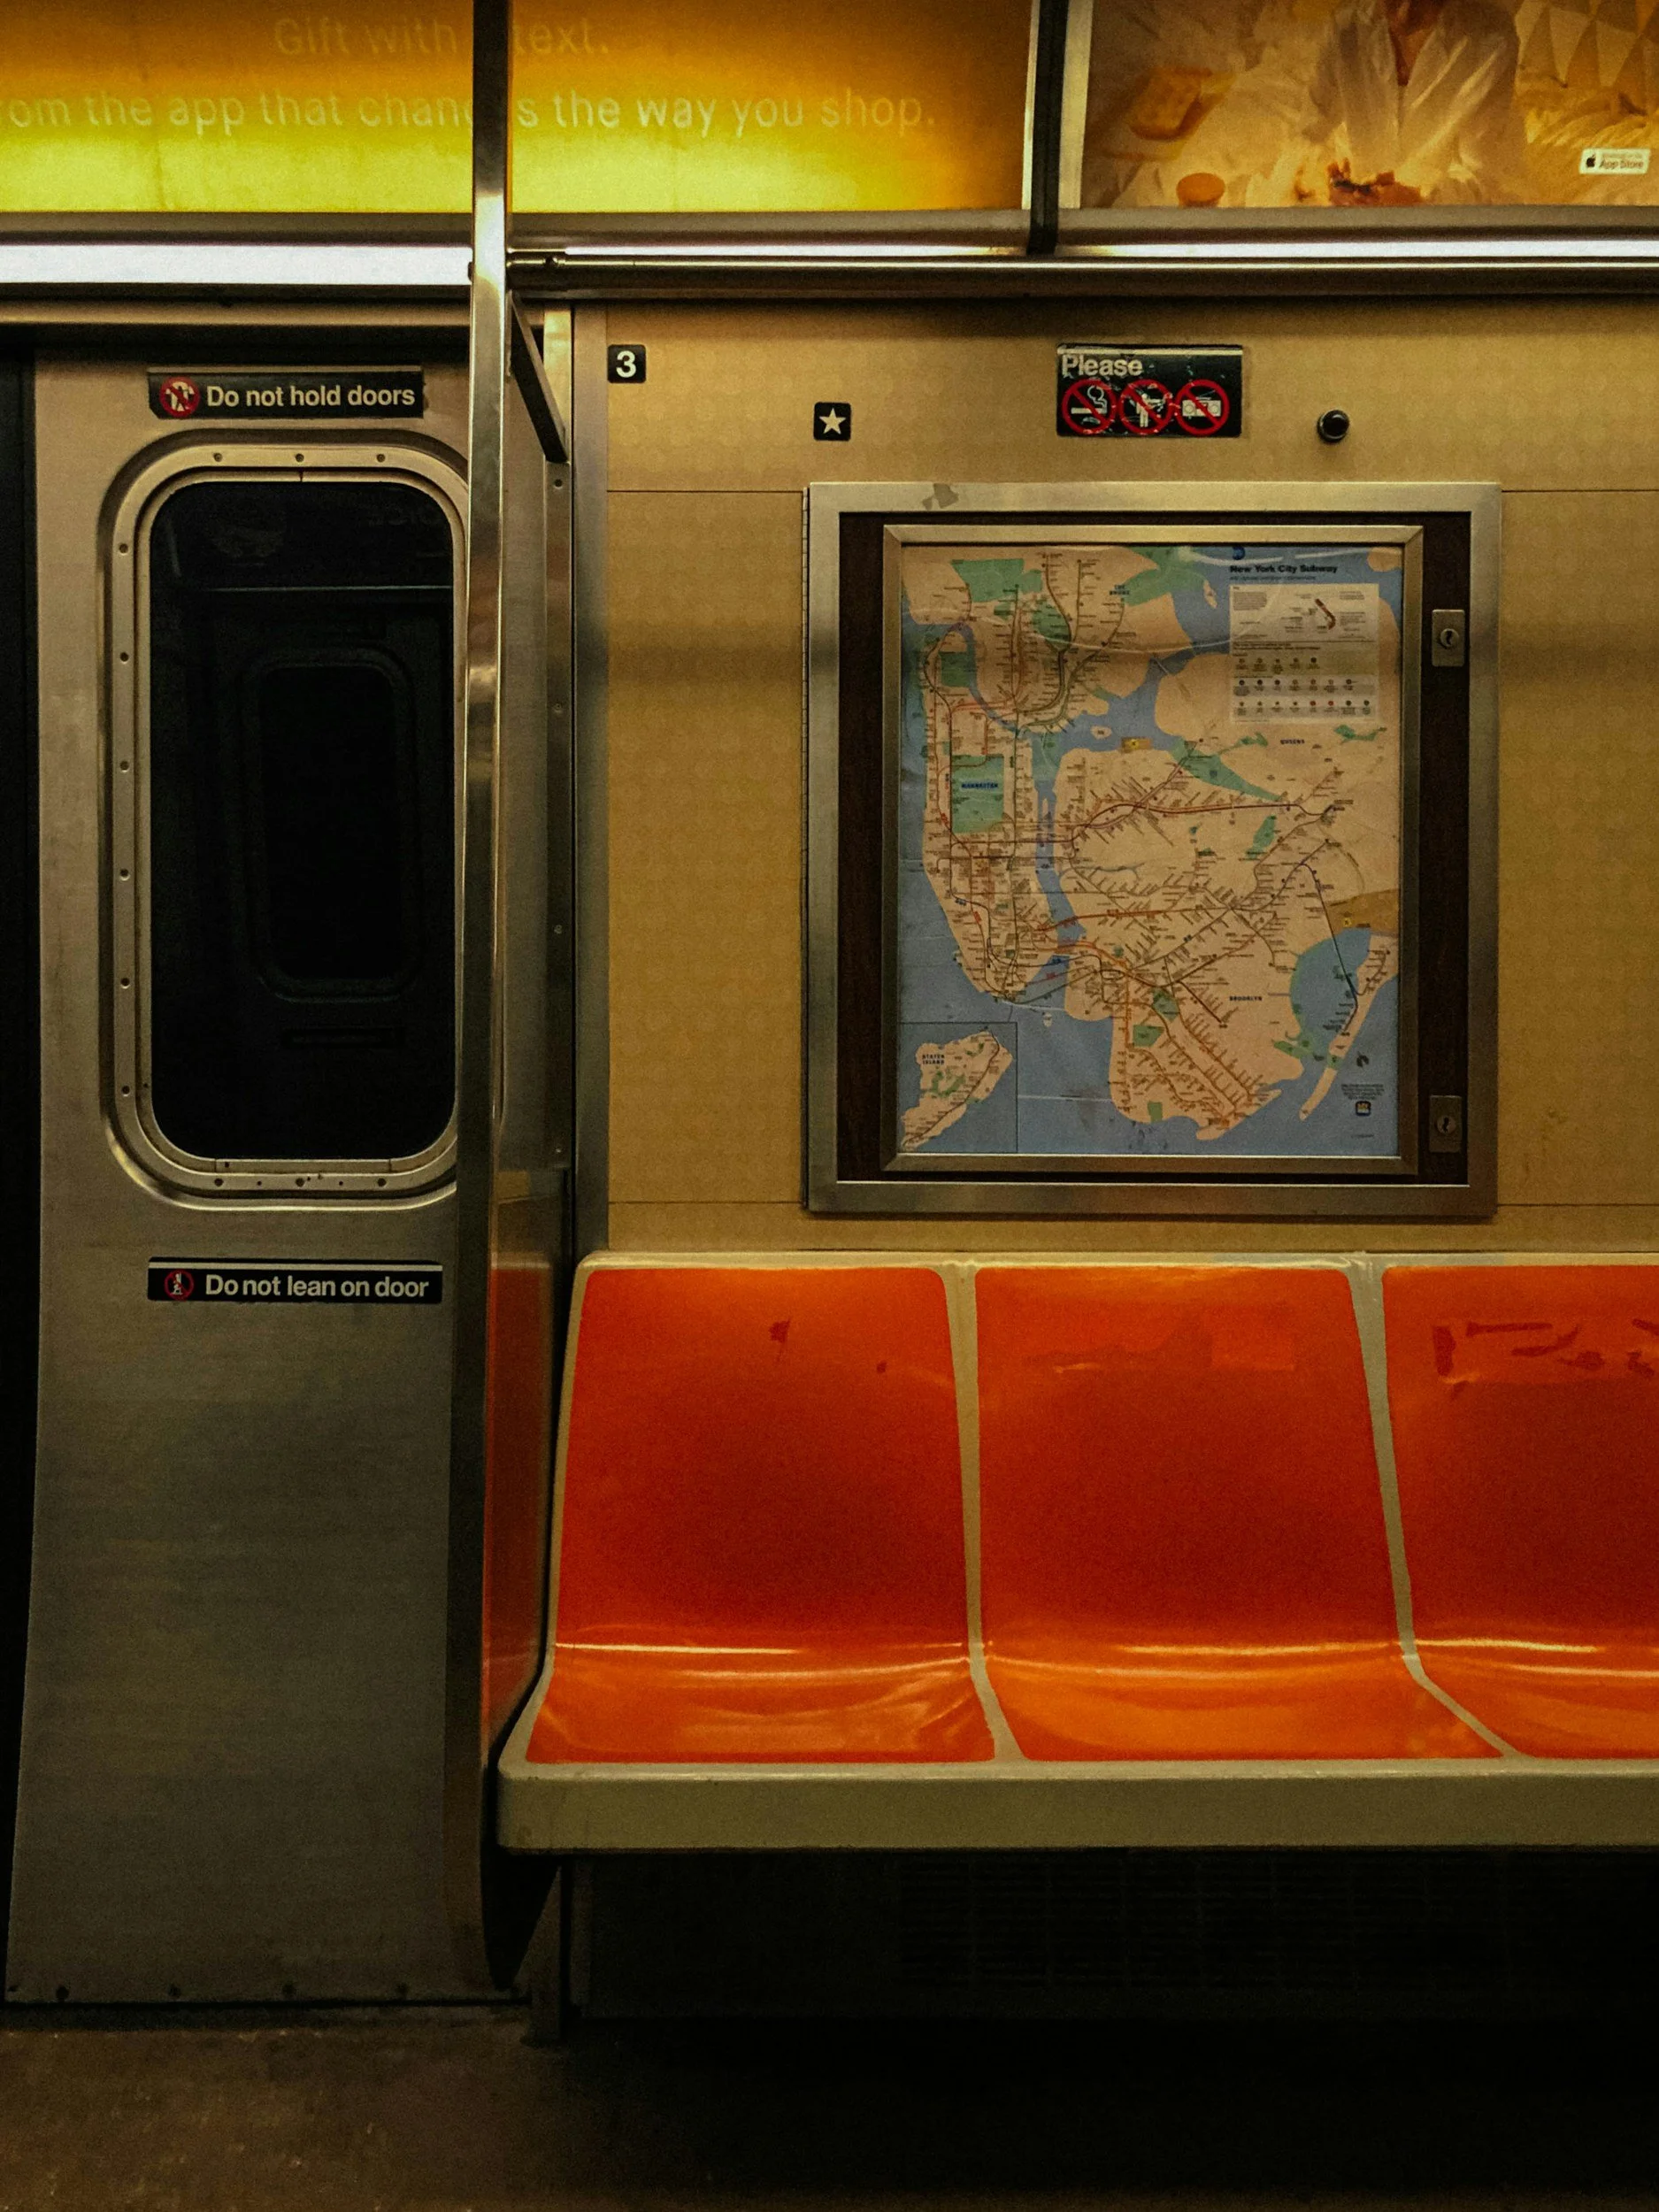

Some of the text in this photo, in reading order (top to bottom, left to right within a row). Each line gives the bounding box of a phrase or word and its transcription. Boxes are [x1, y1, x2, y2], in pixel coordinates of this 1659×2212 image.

[273, 17, 349, 56] Gift
[365, 18, 458, 56] with
[86, 88, 154, 128] the
[168, 96, 245, 137] app
[260, 88, 344, 128] that
[552, 88, 621, 128] the
[636, 96, 718, 138] way
[733, 96, 804, 139] you
[820, 87, 936, 137] shop.
[616, 349, 637, 379] 3
[1062, 354, 1143, 376] Please
[206, 384, 416, 407] Do not hold doors
[205, 1274, 429, 1298] Do not lean on door
